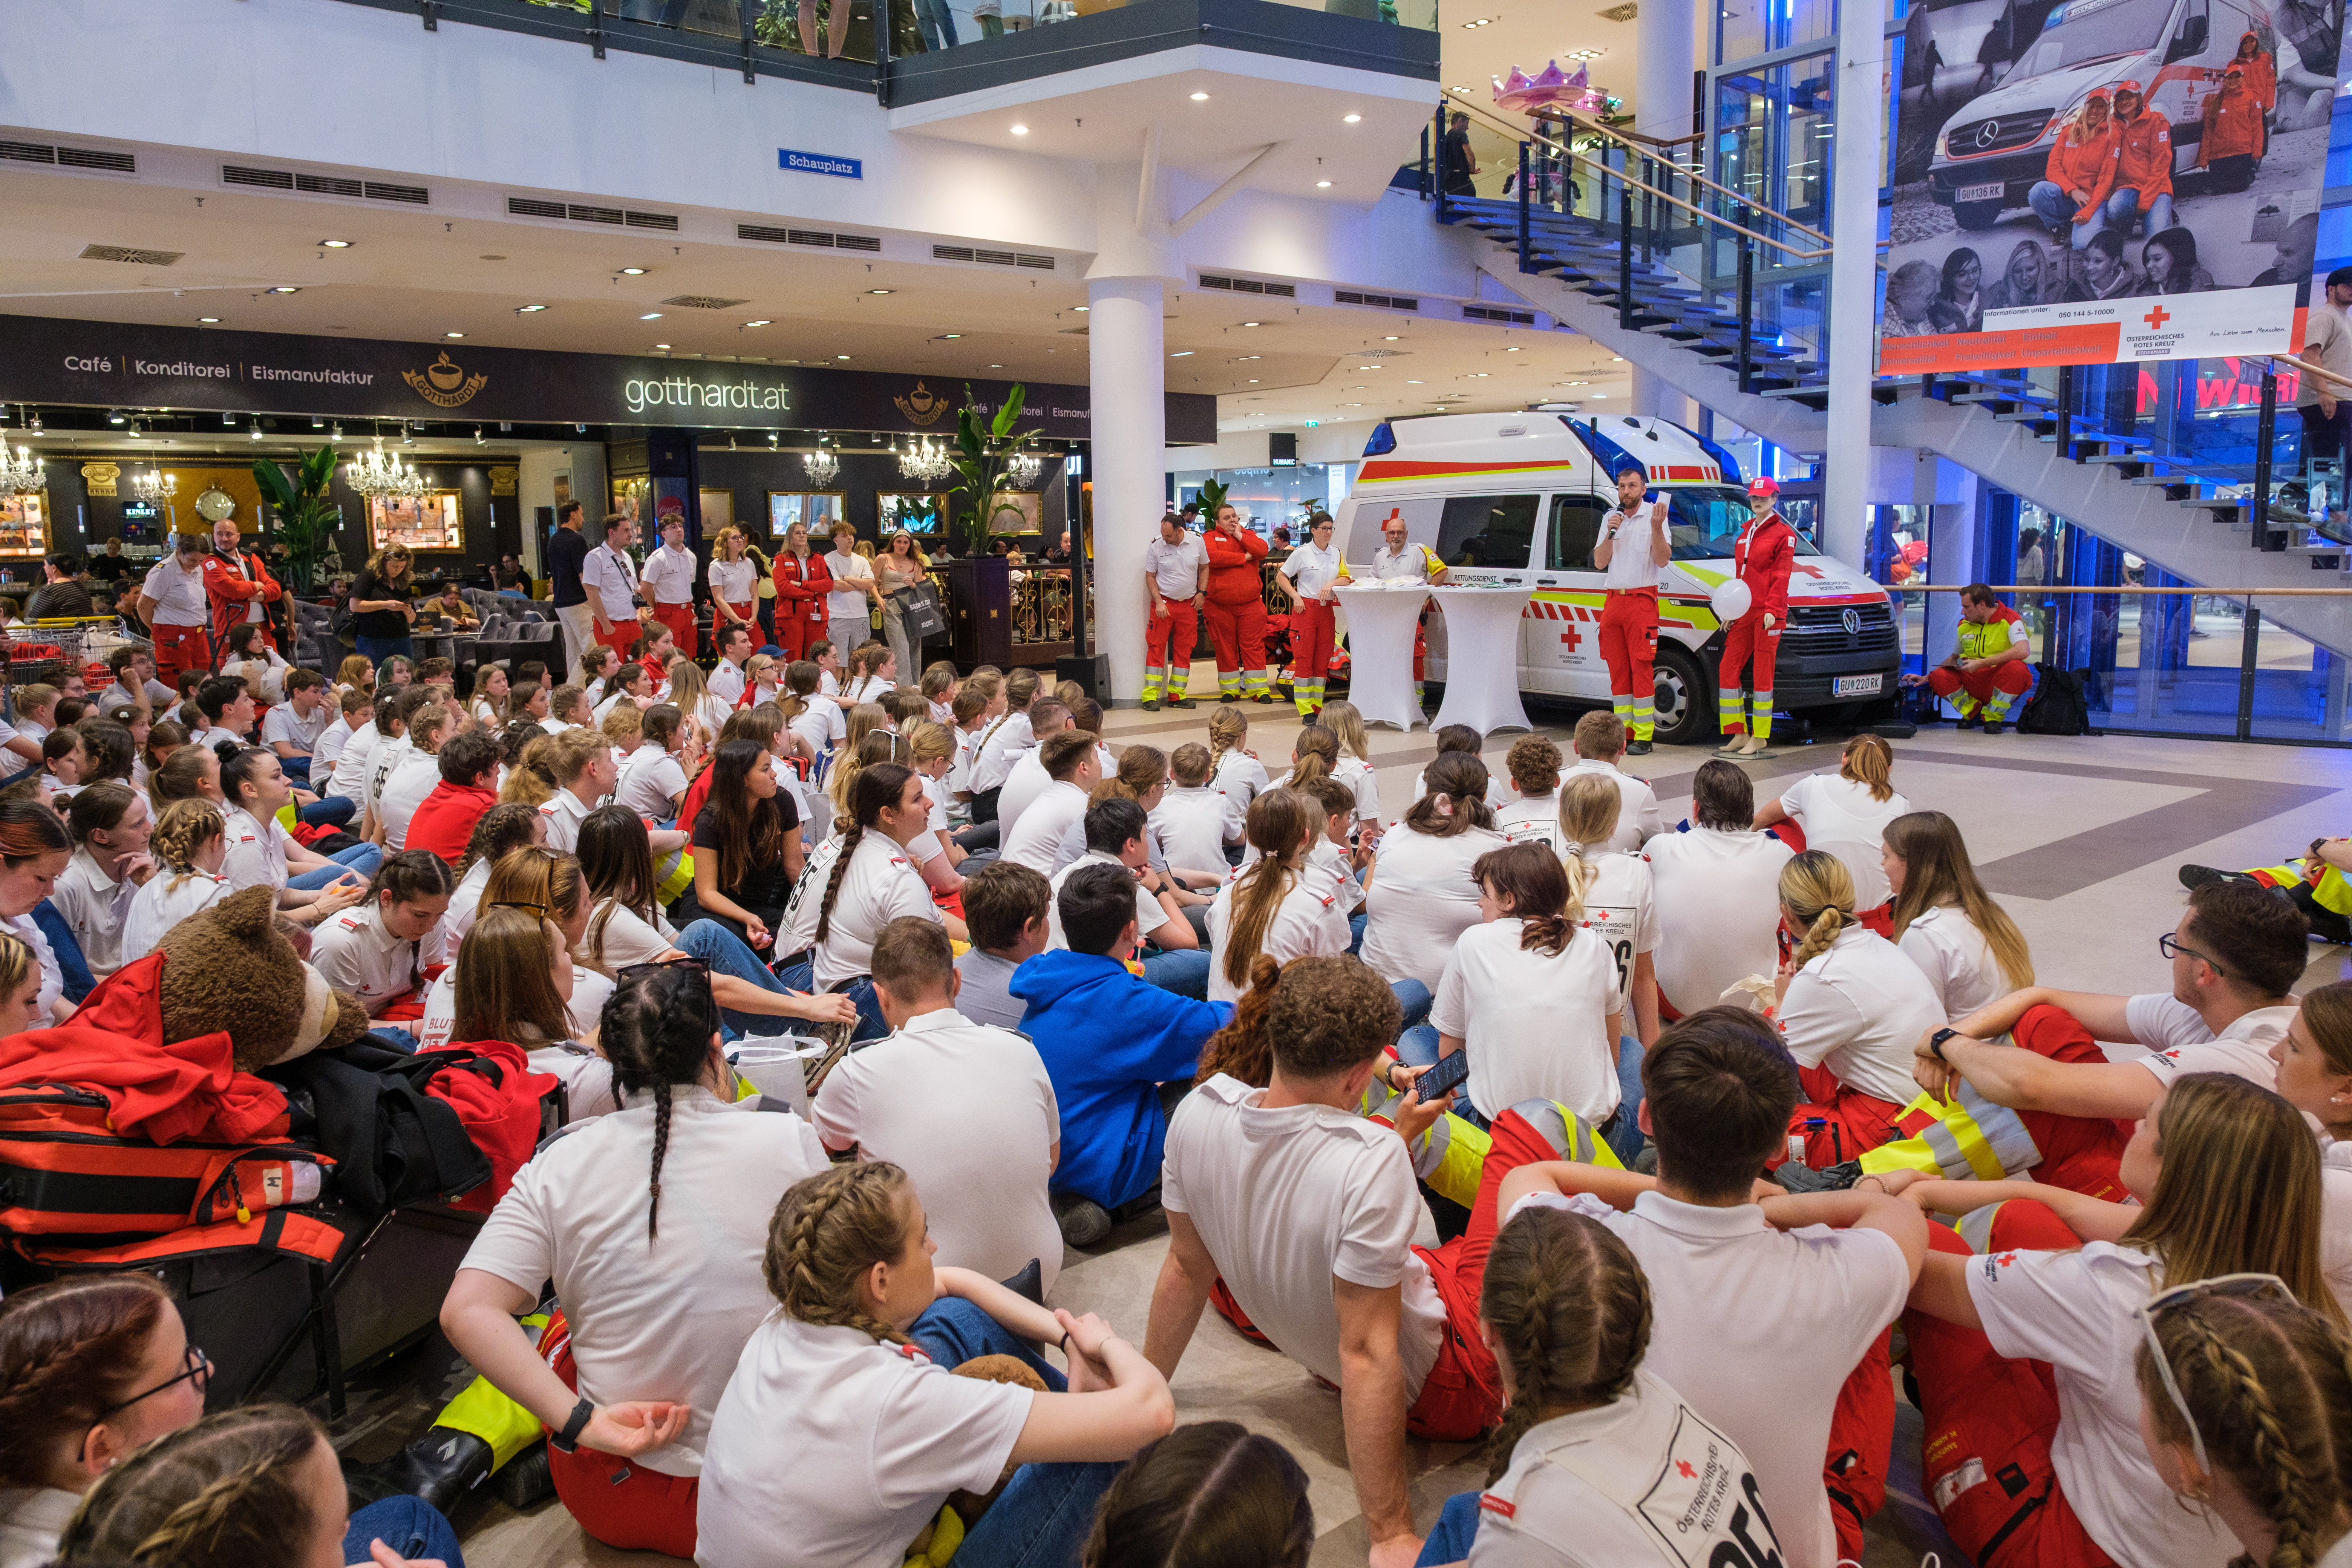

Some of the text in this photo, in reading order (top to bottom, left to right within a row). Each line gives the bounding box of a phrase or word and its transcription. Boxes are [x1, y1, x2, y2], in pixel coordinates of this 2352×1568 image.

[789, 155, 853, 172] Schauplatz
[1976, 187, 1988, 198] 136
[1990, 185, 2000, 196] RK
[2023, 332, 2057, 341] Einheit
[2126, 333, 2185, 342] ÖSTERREICHISCHES
[64, 356, 374, 385] Café Konditorei Eismanufaktur
[416, 381, 476, 405] GOTTHARDT
[625, 377, 790, 413] gotthardt.at
[902, 405, 941, 424] GOTTHARDT
[1053, 407, 1090, 418] Eismanuf
[1841, 677, 1879, 691] GU 220 RK
[1701, 1495, 1722, 1532] ROTES
